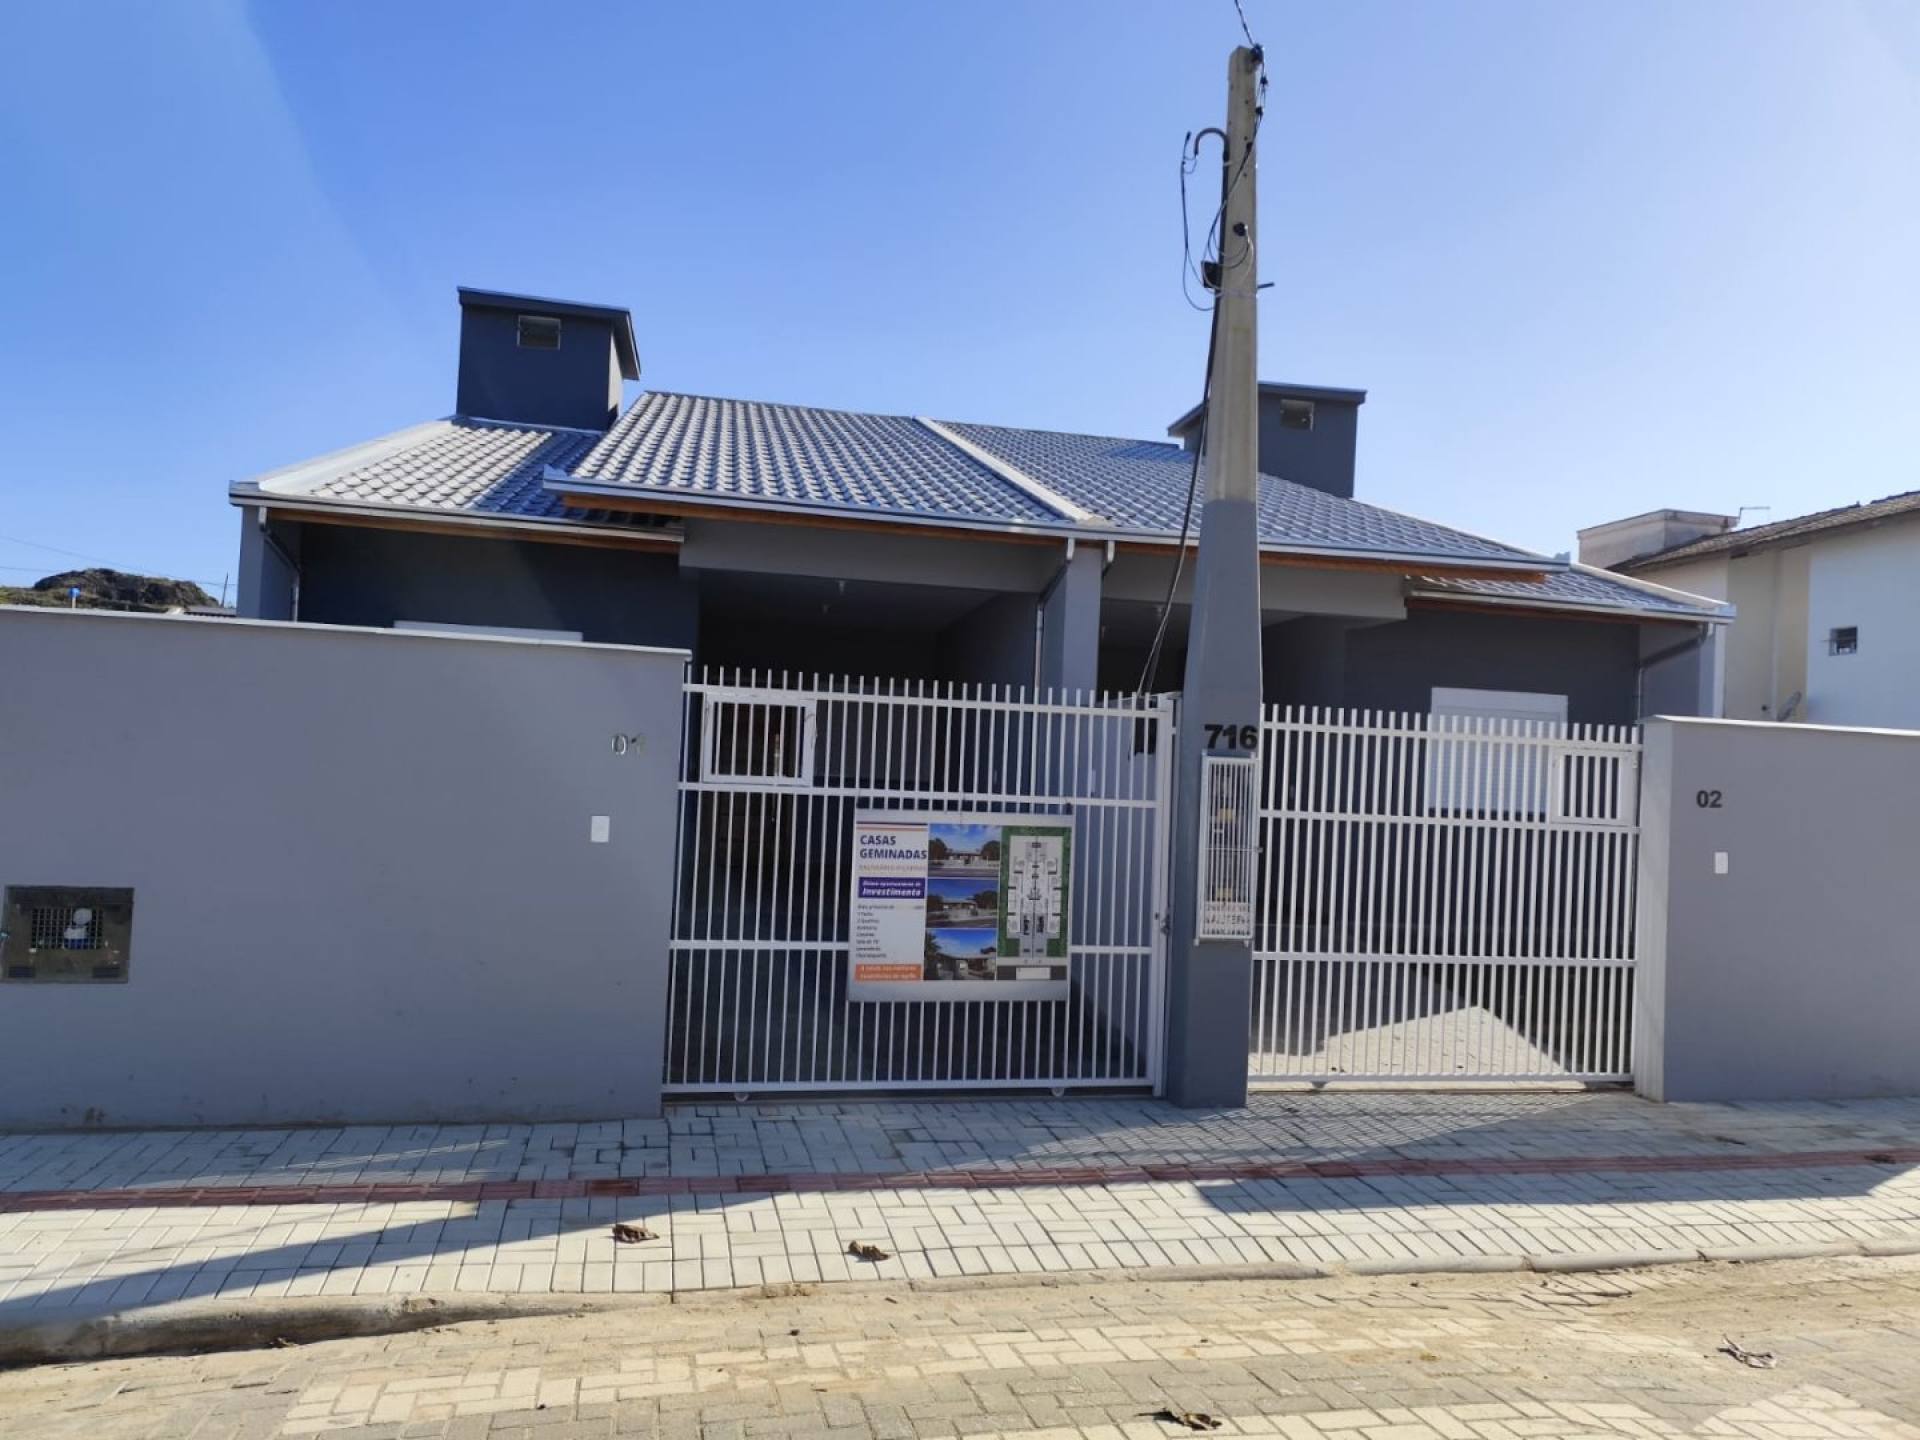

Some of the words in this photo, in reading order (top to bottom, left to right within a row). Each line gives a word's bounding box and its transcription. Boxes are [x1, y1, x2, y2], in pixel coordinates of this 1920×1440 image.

[1204, 724, 1258, 750] 716
[1696, 790, 1722, 808] 02
[860, 835, 896, 845] CASAS
[860, 848, 928, 860] GEMINADAS
[862, 887, 921, 897] Investimento
